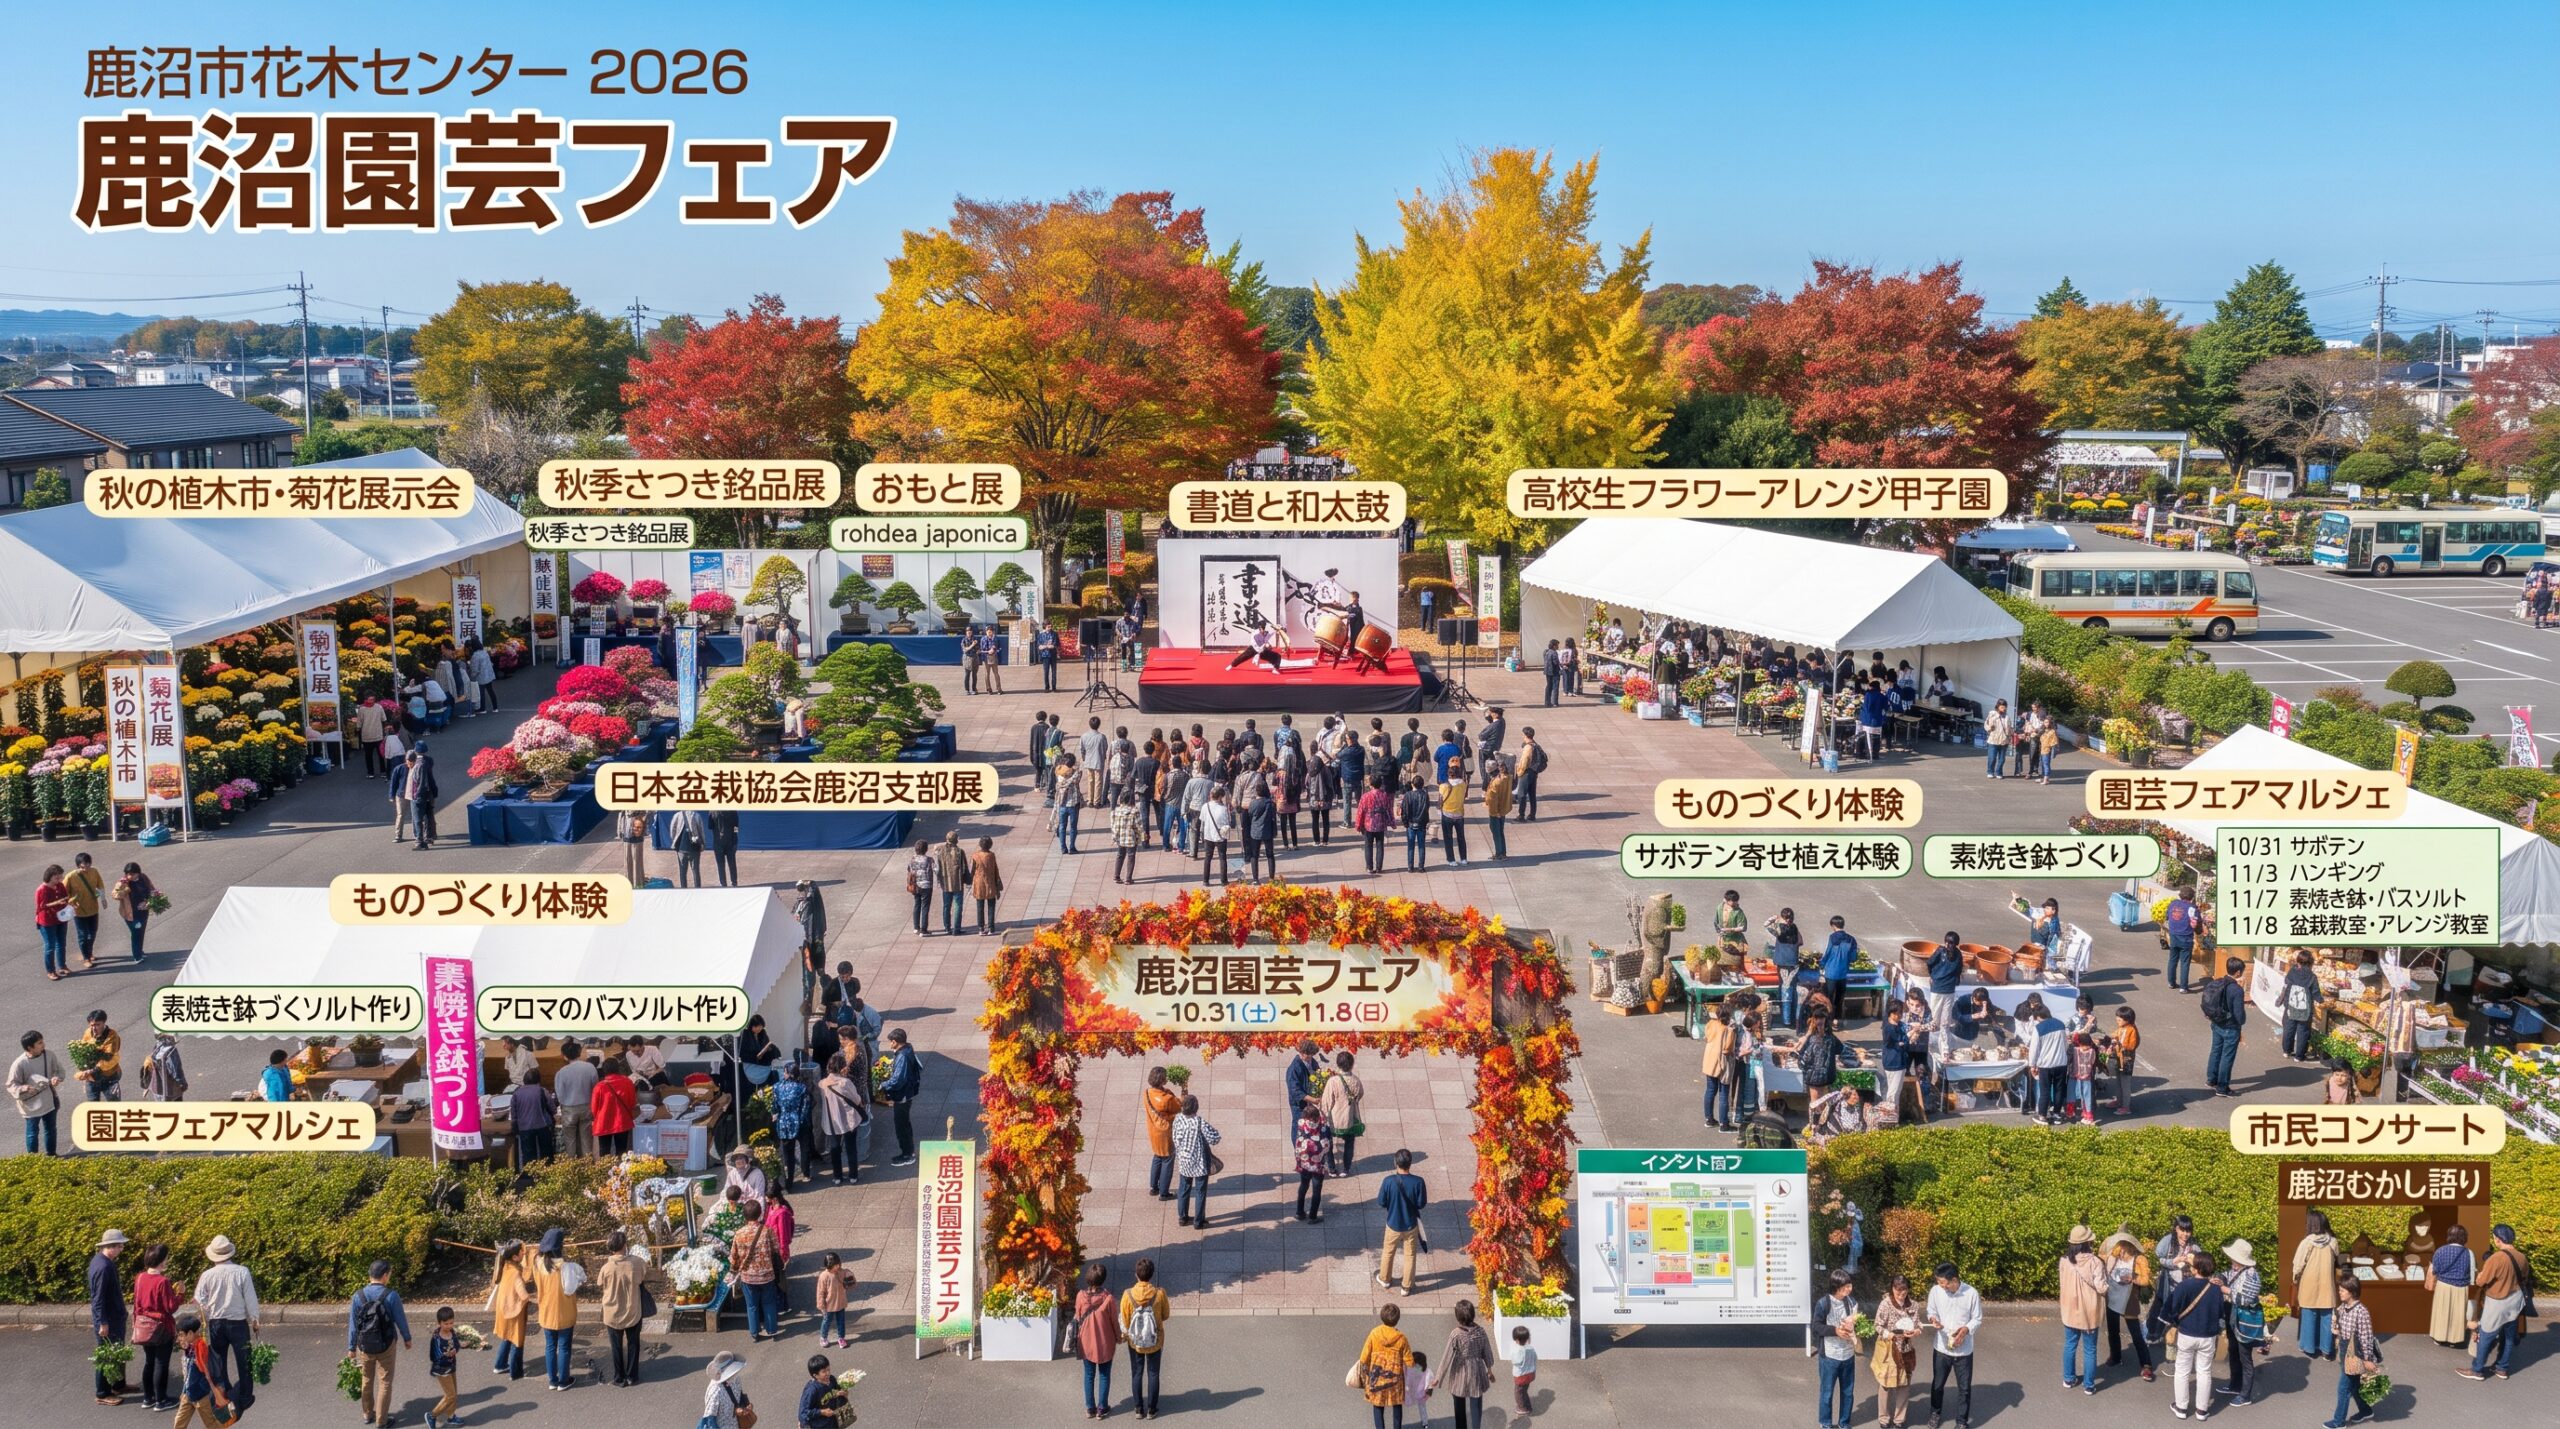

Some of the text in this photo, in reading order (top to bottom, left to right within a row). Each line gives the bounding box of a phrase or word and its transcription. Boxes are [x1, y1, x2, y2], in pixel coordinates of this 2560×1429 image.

[111, 675, 137, 784] 秋の植木市
[1135, 955, 1420, 996] 鹿沼園芸フェア
[2288, 1168, 2479, 1199] 鹿沼むかし語り
[938, 1156, 963, 1321] 鹿沼園芸フェア
